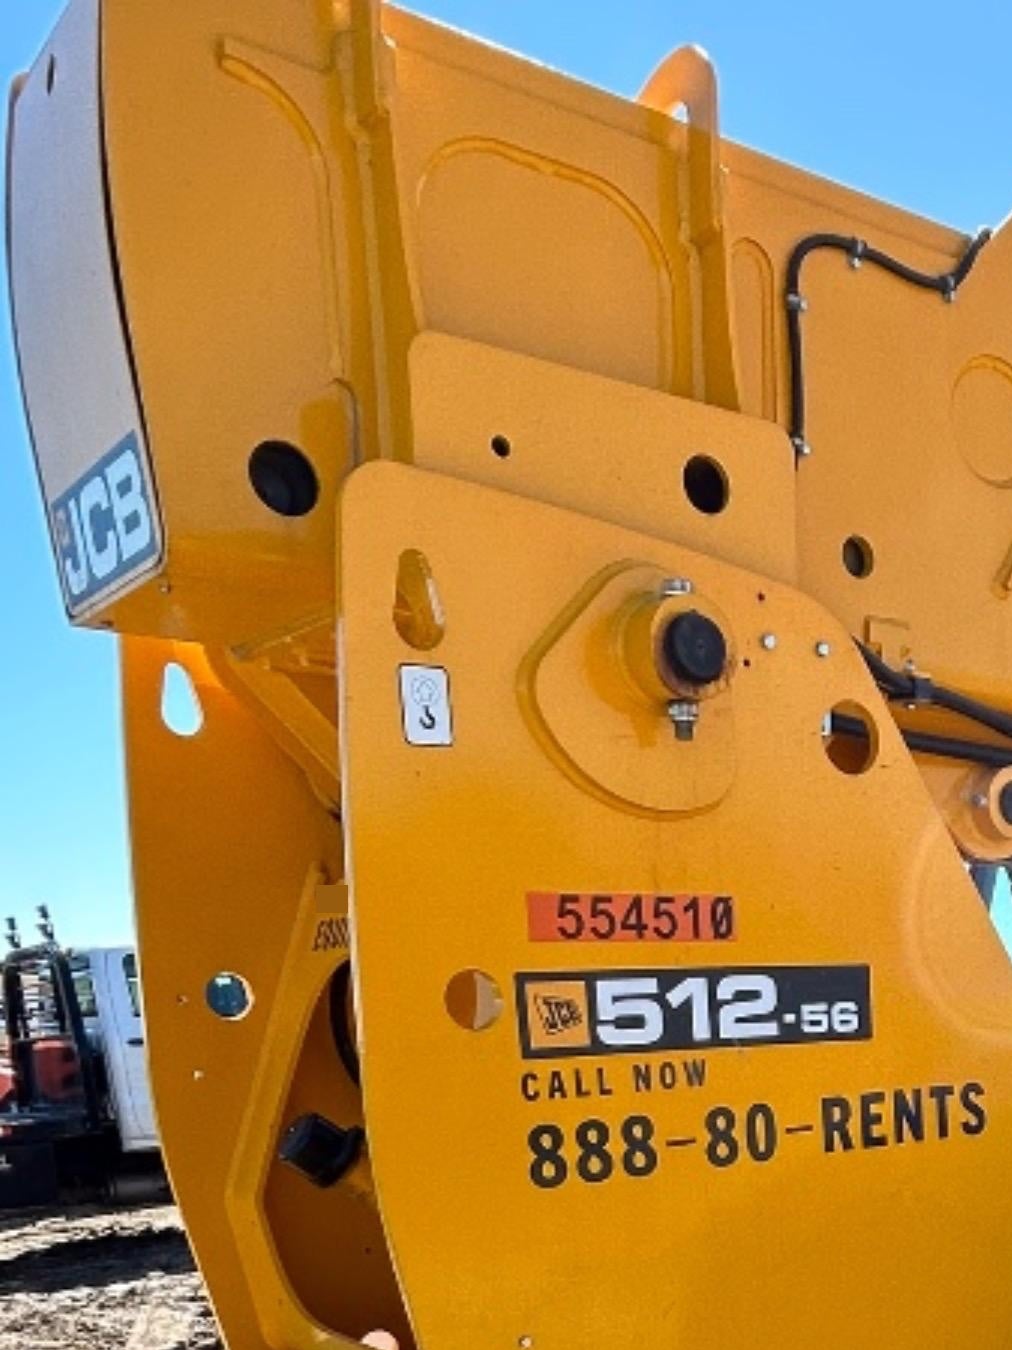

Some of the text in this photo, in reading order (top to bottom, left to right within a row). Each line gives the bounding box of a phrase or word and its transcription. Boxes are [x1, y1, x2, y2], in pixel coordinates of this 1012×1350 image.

[64, 449, 151, 596] JCB
[556, 894, 735, 941] 554510
[520, 1059, 708, 1102] CALL NOW
[526, 1081, 987, 1189] 888-80-RENTS
